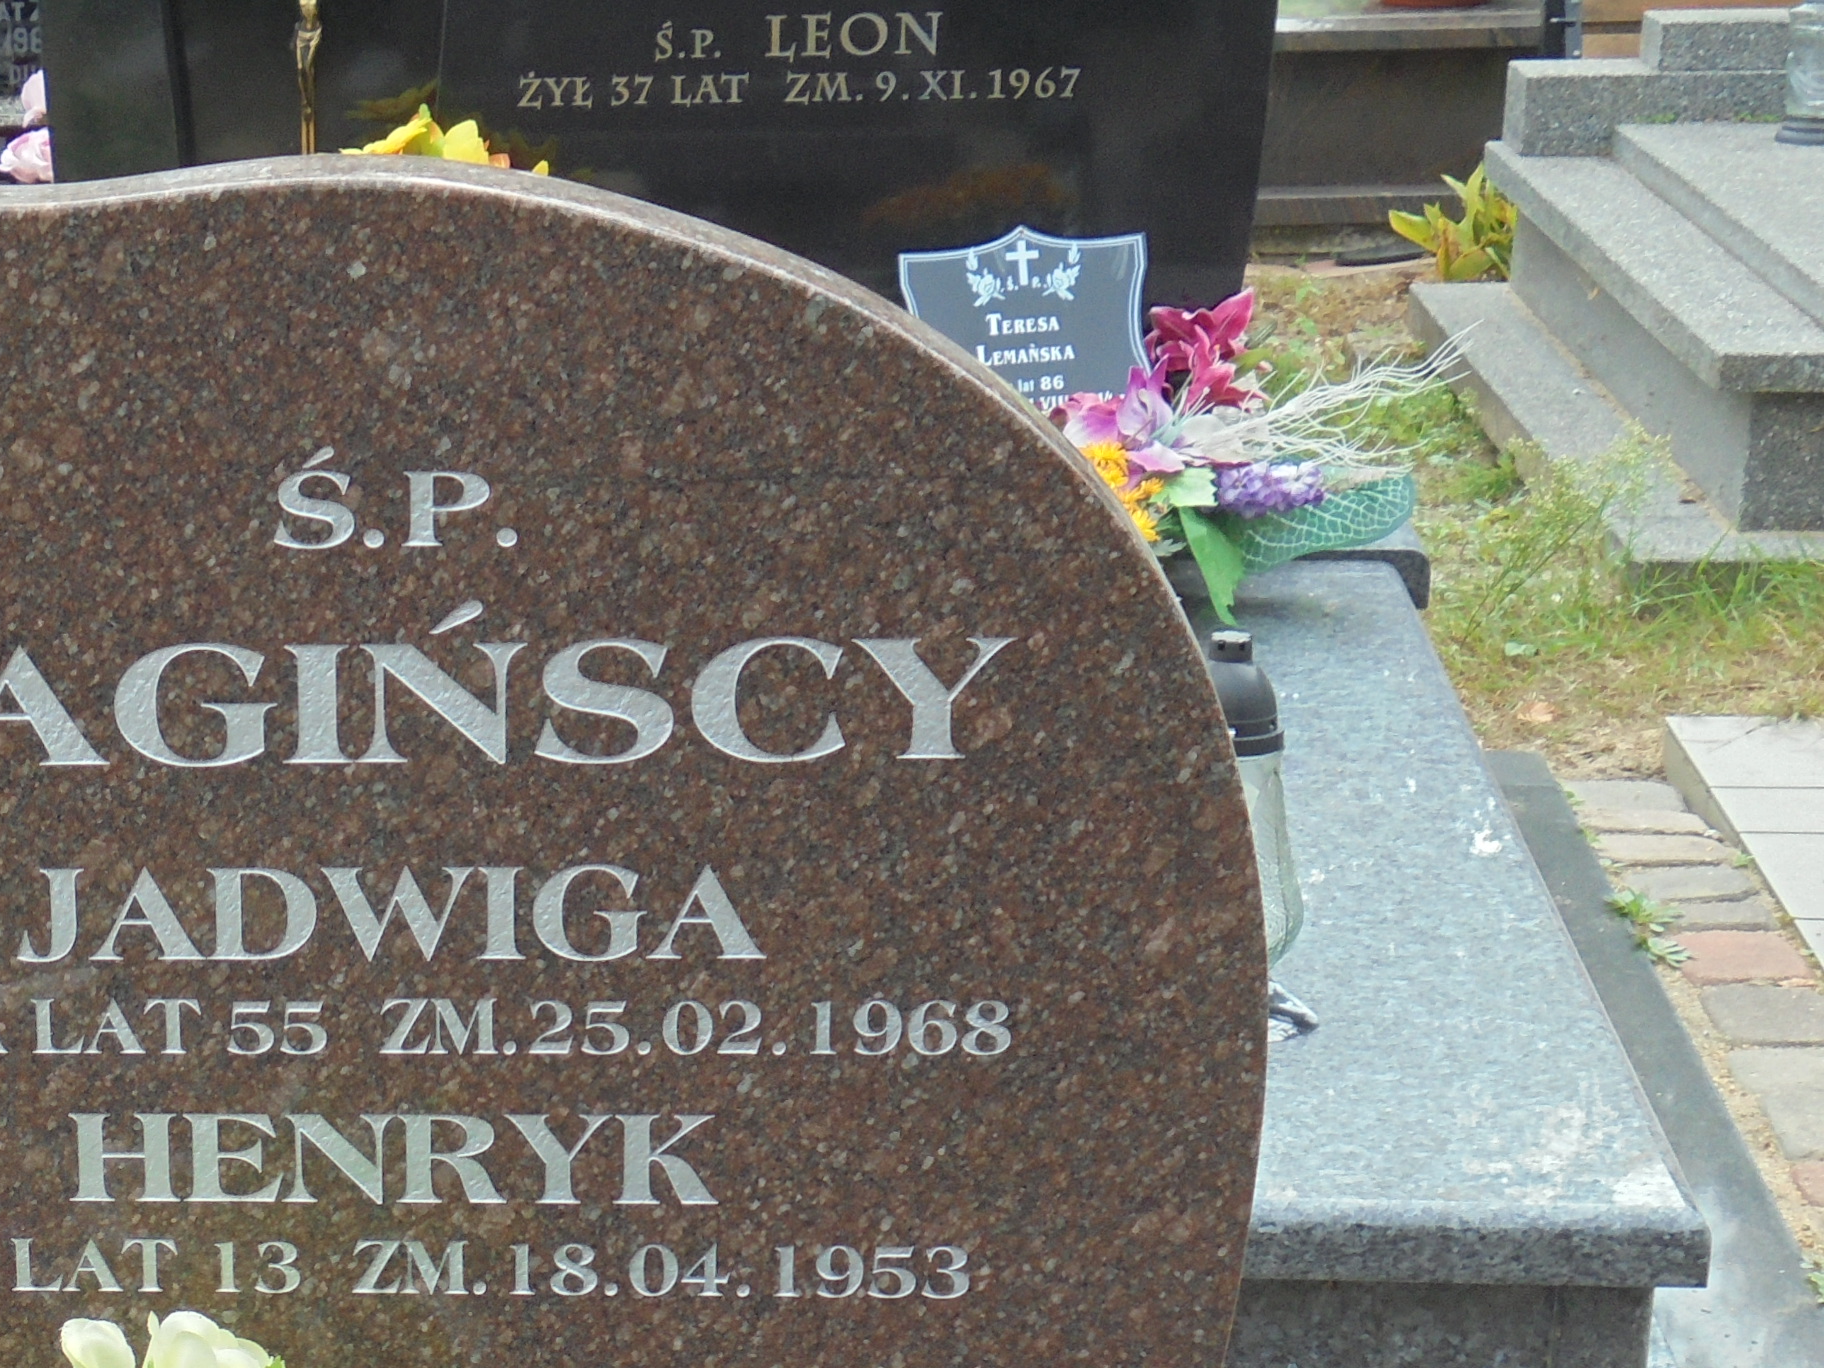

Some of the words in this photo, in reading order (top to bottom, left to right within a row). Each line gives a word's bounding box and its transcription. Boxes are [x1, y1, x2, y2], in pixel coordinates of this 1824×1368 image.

[764, 11, 943, 63] LEON
[517, 71, 593, 109] ŻYŁ
[610, 74, 654, 107] 37
[671, 71, 750, 108] LAT
[985, 313, 1060, 337] TERESA
[975, 343, 1076, 367] LEMAŃSKA
[1040, 375, 1065, 391] 86
[272, 446, 518, 550] Ś.P.
[16, 863, 767, 963] JADWIGA
[30, 997, 202, 1056] LAT
[226, 999, 328, 1057] 55
[67, 1112, 719, 1206] HENRYK
[10, 1237, 179, 1295] LAT
[214, 1240, 302, 1295] 13
